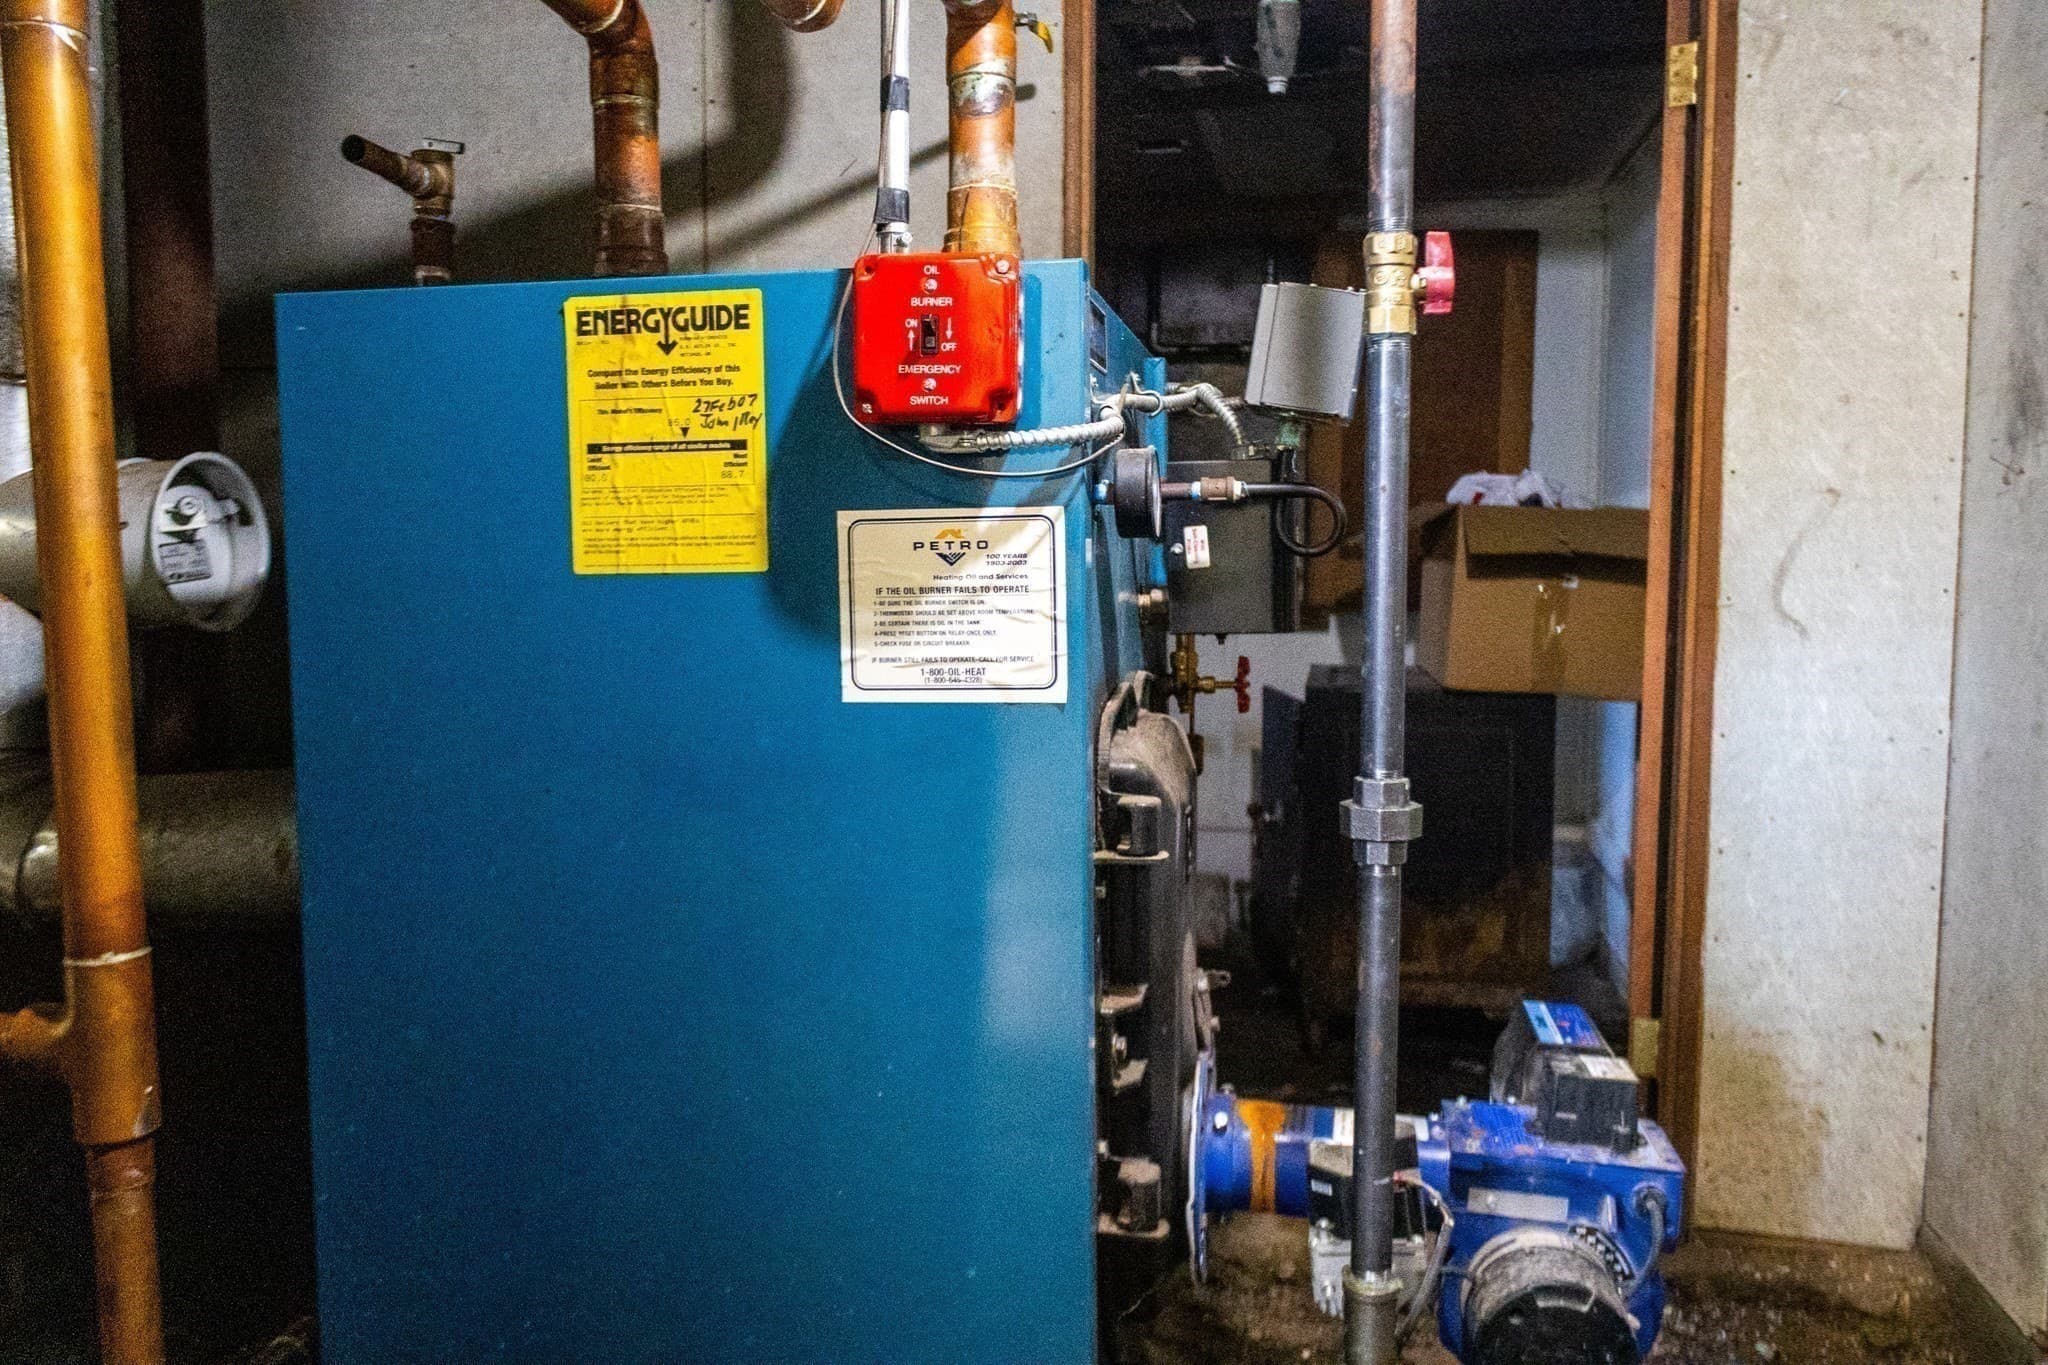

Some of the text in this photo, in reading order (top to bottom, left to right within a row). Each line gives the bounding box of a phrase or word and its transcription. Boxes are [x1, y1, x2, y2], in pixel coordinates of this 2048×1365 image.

[924, 266, 939, 275] OIL
[911, 297, 952, 306] BURNER
[576, 304, 750, 337] ENERGYGUIDE
[905, 319, 918, 328] ON
[941, 343, 957, 351] OFF
[587, 364, 741, 378] Compare the Energy Efficiency of this
[898, 365, 961, 374] EMERGENCY
[641, 380, 668, 388] Others
[670, 379, 697, 387] Before
[700, 379, 714, 387] You
[910, 396, 948, 405] SWITCH
[913, 541, 988, 550] PETRO
[887, 587, 900, 595] THE
[903, 587, 916, 595] OIL
[919, 586, 951, 595] BURNER
[993, 585, 1030, 593] OPERATE
[921, 667, 986, 676] 1-800-OIL-HEAT
